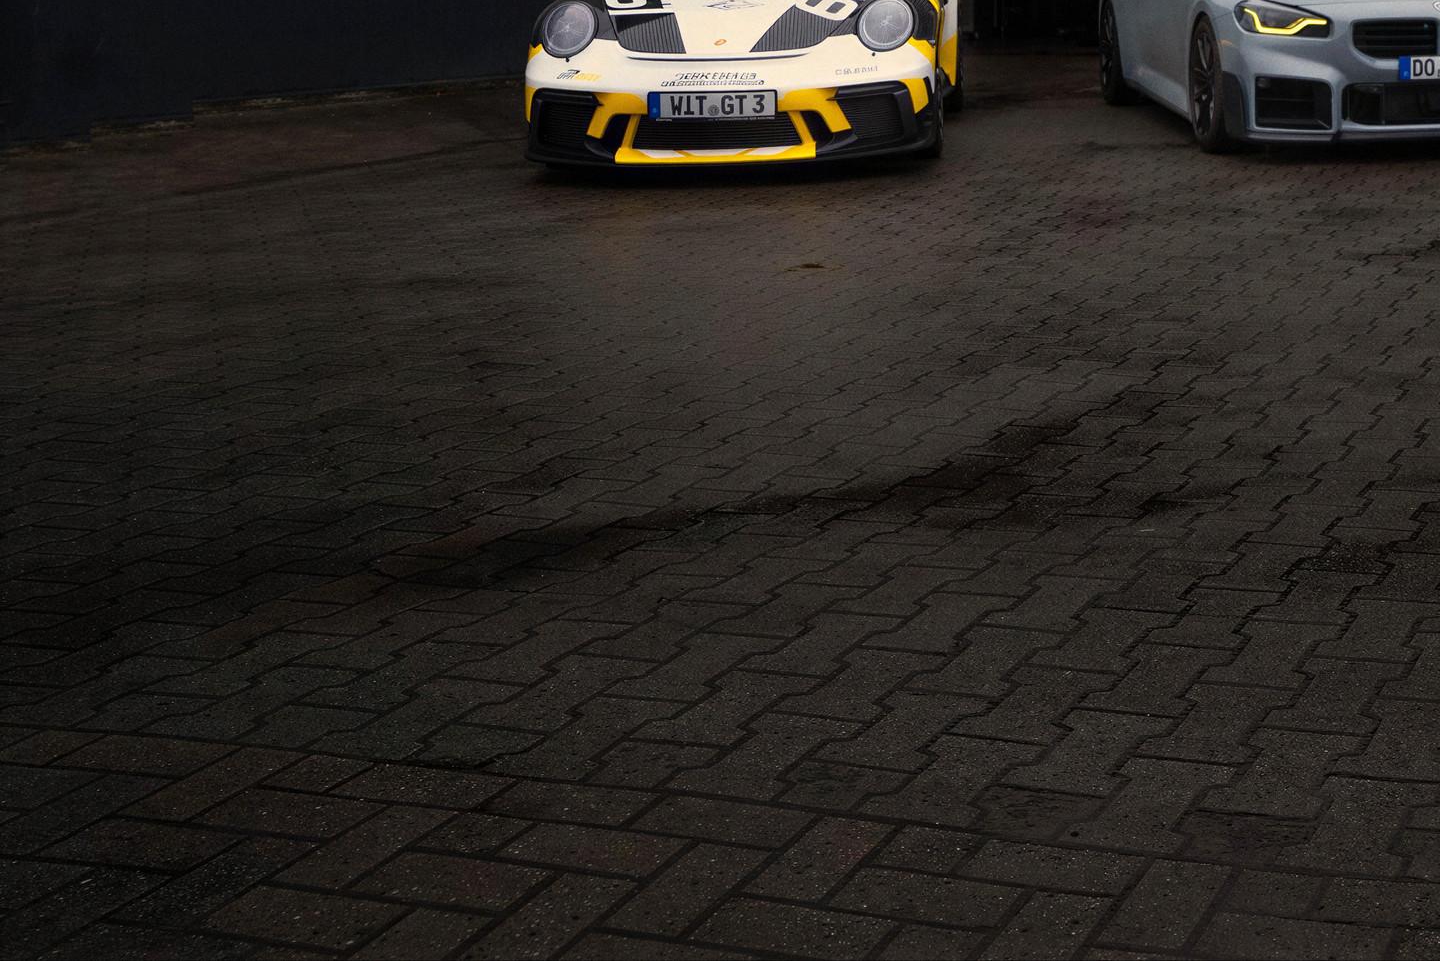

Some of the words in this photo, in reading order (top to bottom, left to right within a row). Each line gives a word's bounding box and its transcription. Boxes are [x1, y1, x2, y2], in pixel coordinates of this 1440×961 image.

[1412, 59, 1435, 77] DO
[670, 95, 707, 116] WIT
[720, 95, 747, 115] GT
[752, 94, 765, 114] 3
